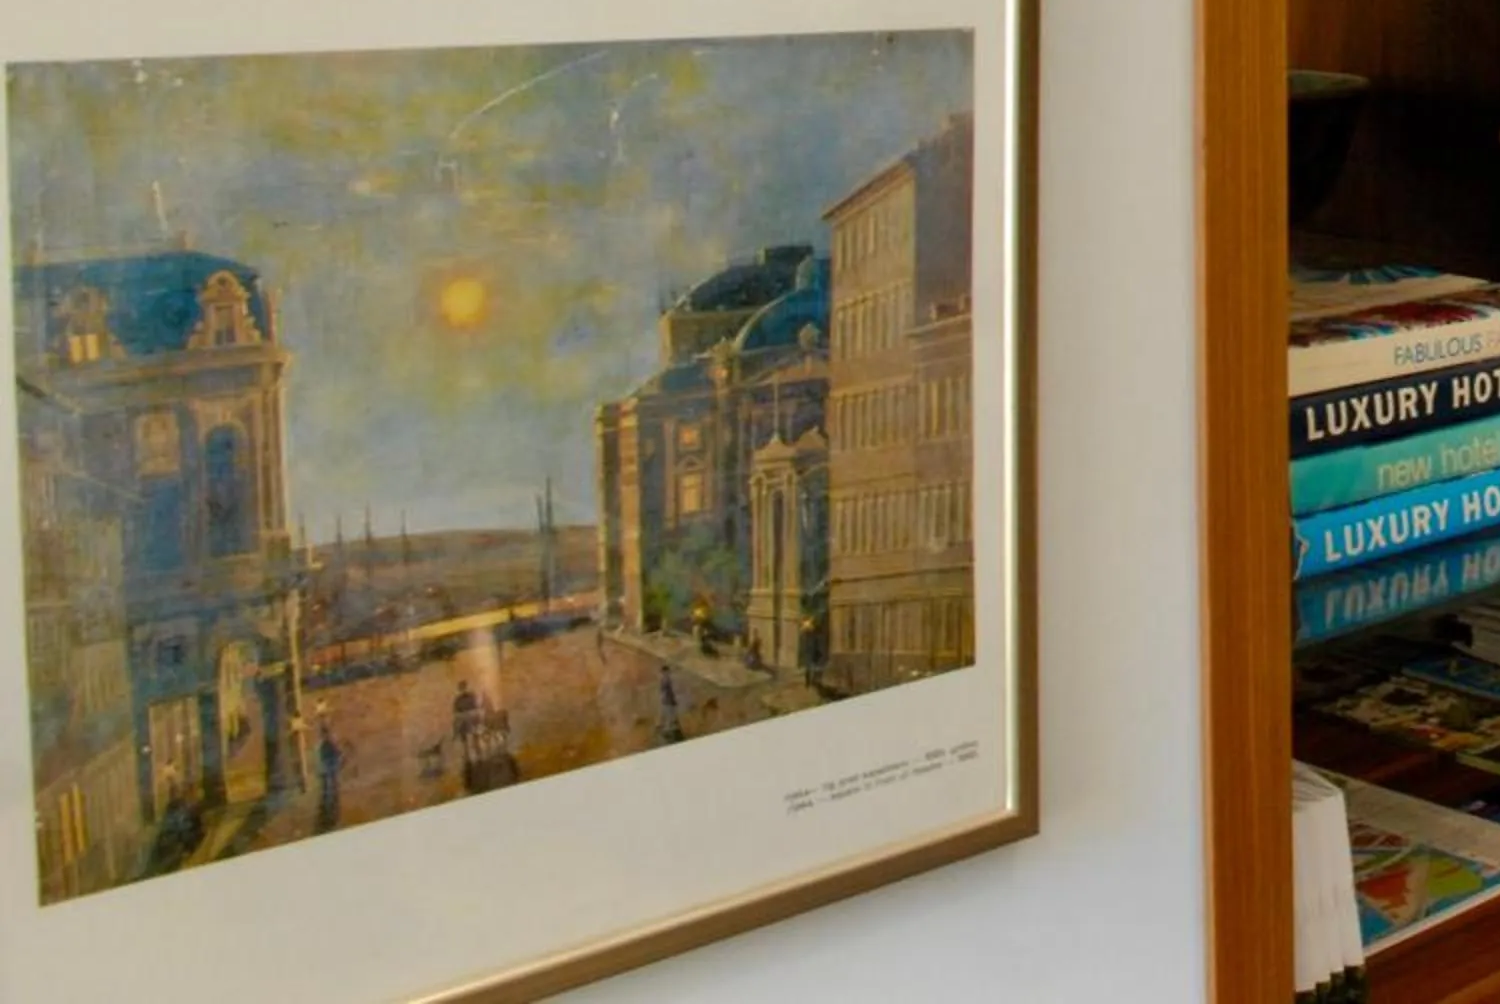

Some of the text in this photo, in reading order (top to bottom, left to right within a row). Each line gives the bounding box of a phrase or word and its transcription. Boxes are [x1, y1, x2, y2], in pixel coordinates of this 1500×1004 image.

[1394, 333, 1483, 366] FABULOUS
[1306, 382, 1438, 442] LUXURY
[1378, 453, 1431, 492] new
[1324, 499, 1449, 562] LUXURY
